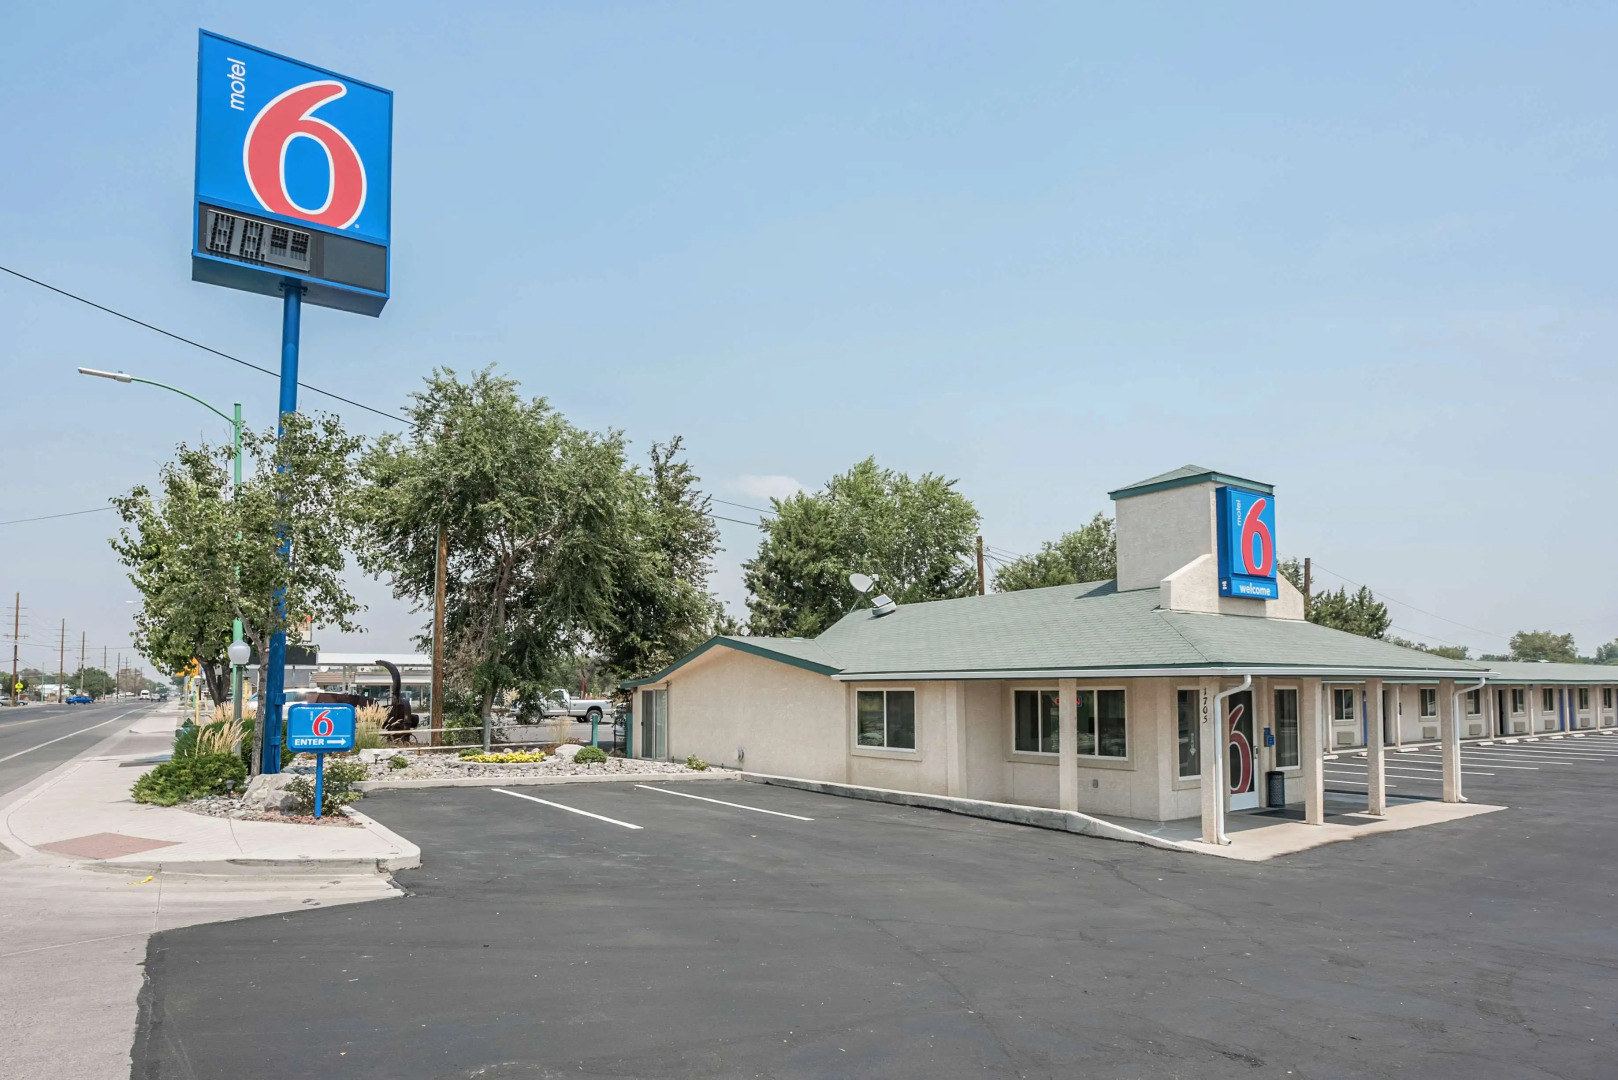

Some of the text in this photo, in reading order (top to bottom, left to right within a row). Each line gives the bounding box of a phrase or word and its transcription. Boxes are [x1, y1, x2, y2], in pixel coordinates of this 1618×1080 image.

[227, 57, 246, 112] motel
[242, 79, 367, 230] 6
[1241, 498, 1273, 577] 6
[1239, 582, 1271, 596] welcome
[294, 738, 325, 746] ENTER
[312, 709, 334, 737] 6
[1229, 703, 1253, 795] 6
